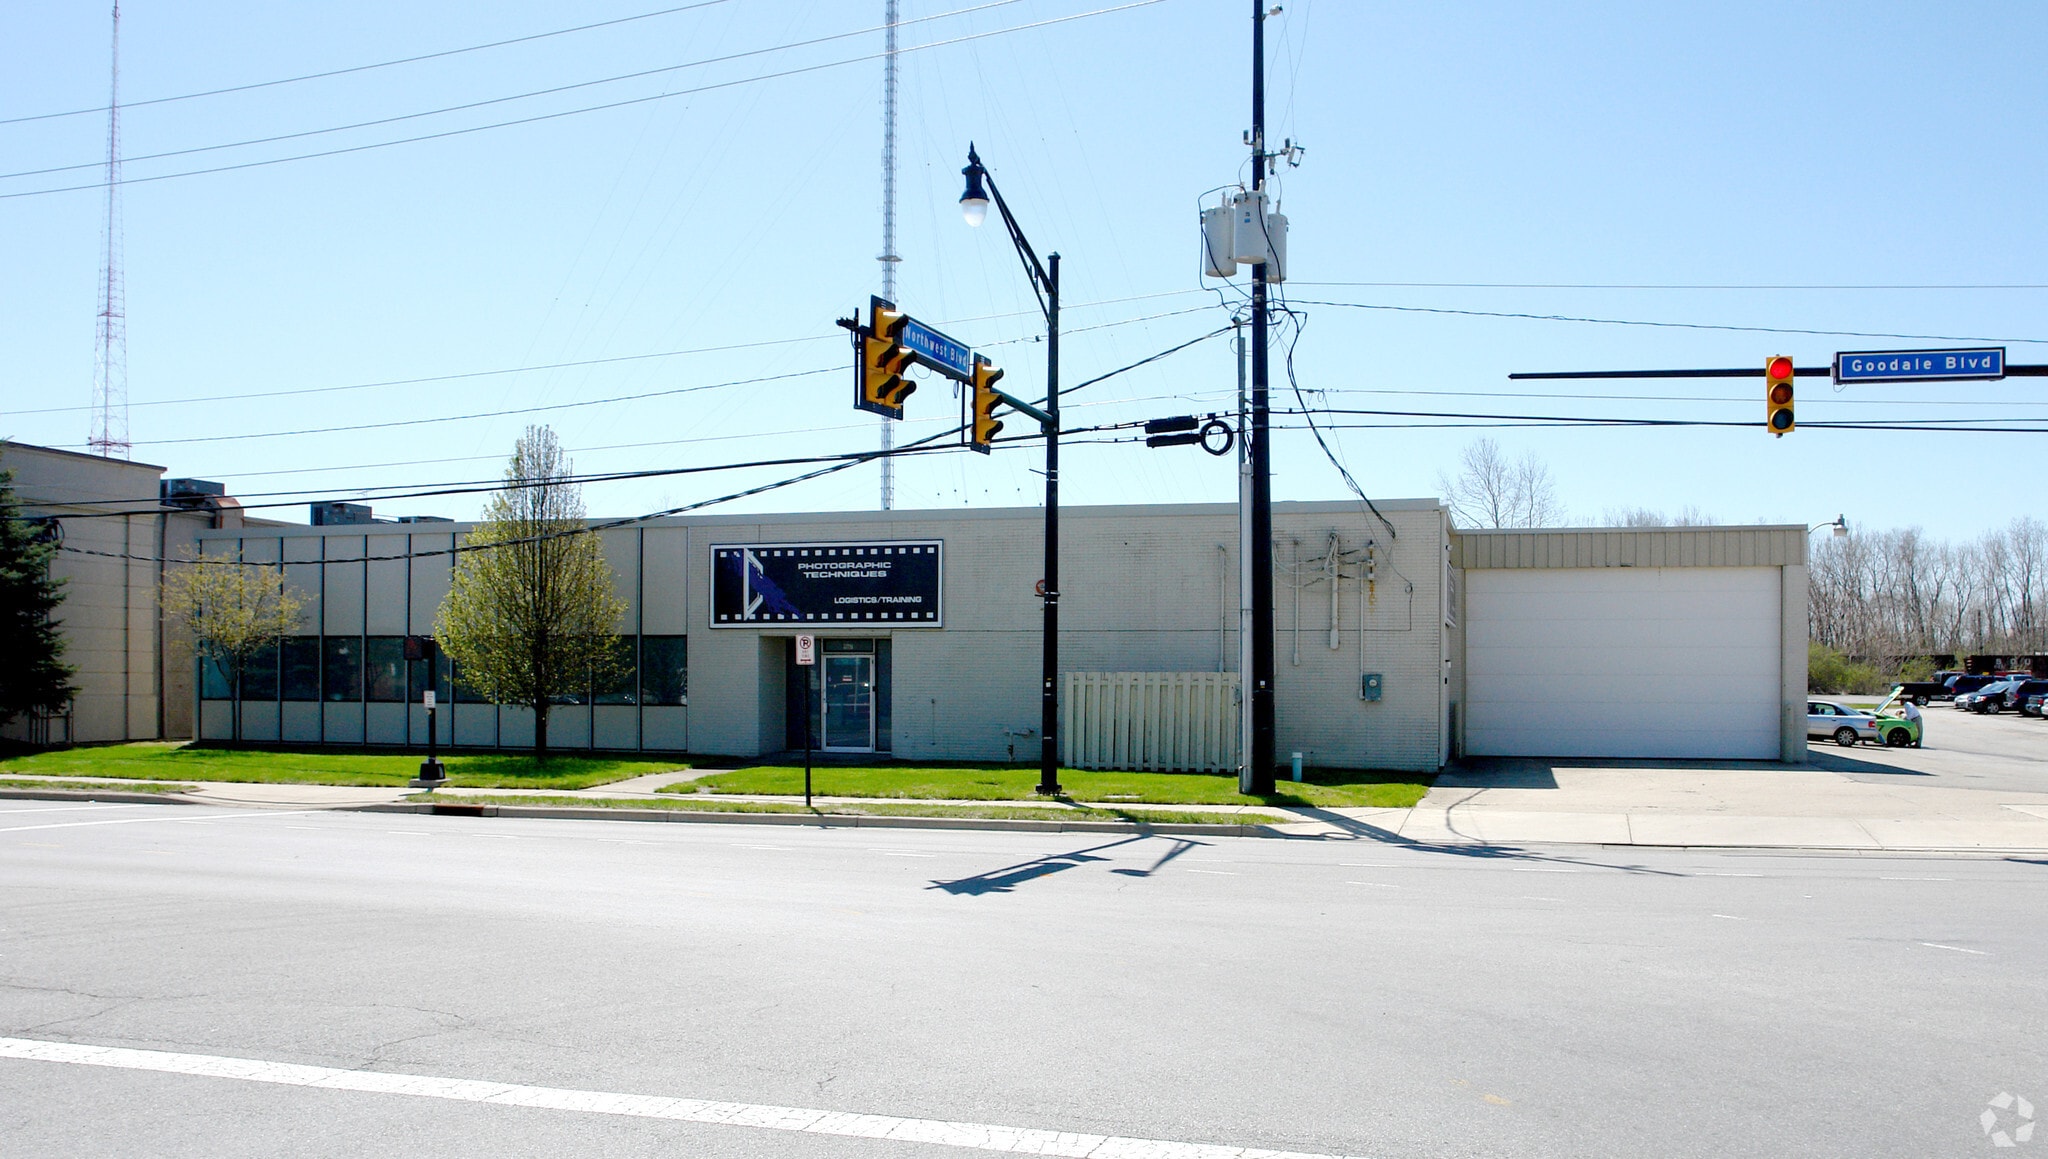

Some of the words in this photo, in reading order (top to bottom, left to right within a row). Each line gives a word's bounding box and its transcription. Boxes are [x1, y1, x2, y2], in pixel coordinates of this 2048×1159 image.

[905, 324, 947, 358] Northwest
[950, 347, 967, 367] Blvd
[1851, 358, 1932, 372] Goodale
[1945, 355, 1991, 369] Blvd
[798, 561, 892, 570] PHOTOGRAPHIC
[803, 570, 887, 579] TECHNIQUES
[834, 596, 922, 604] LOGISTICS/TRAINING
